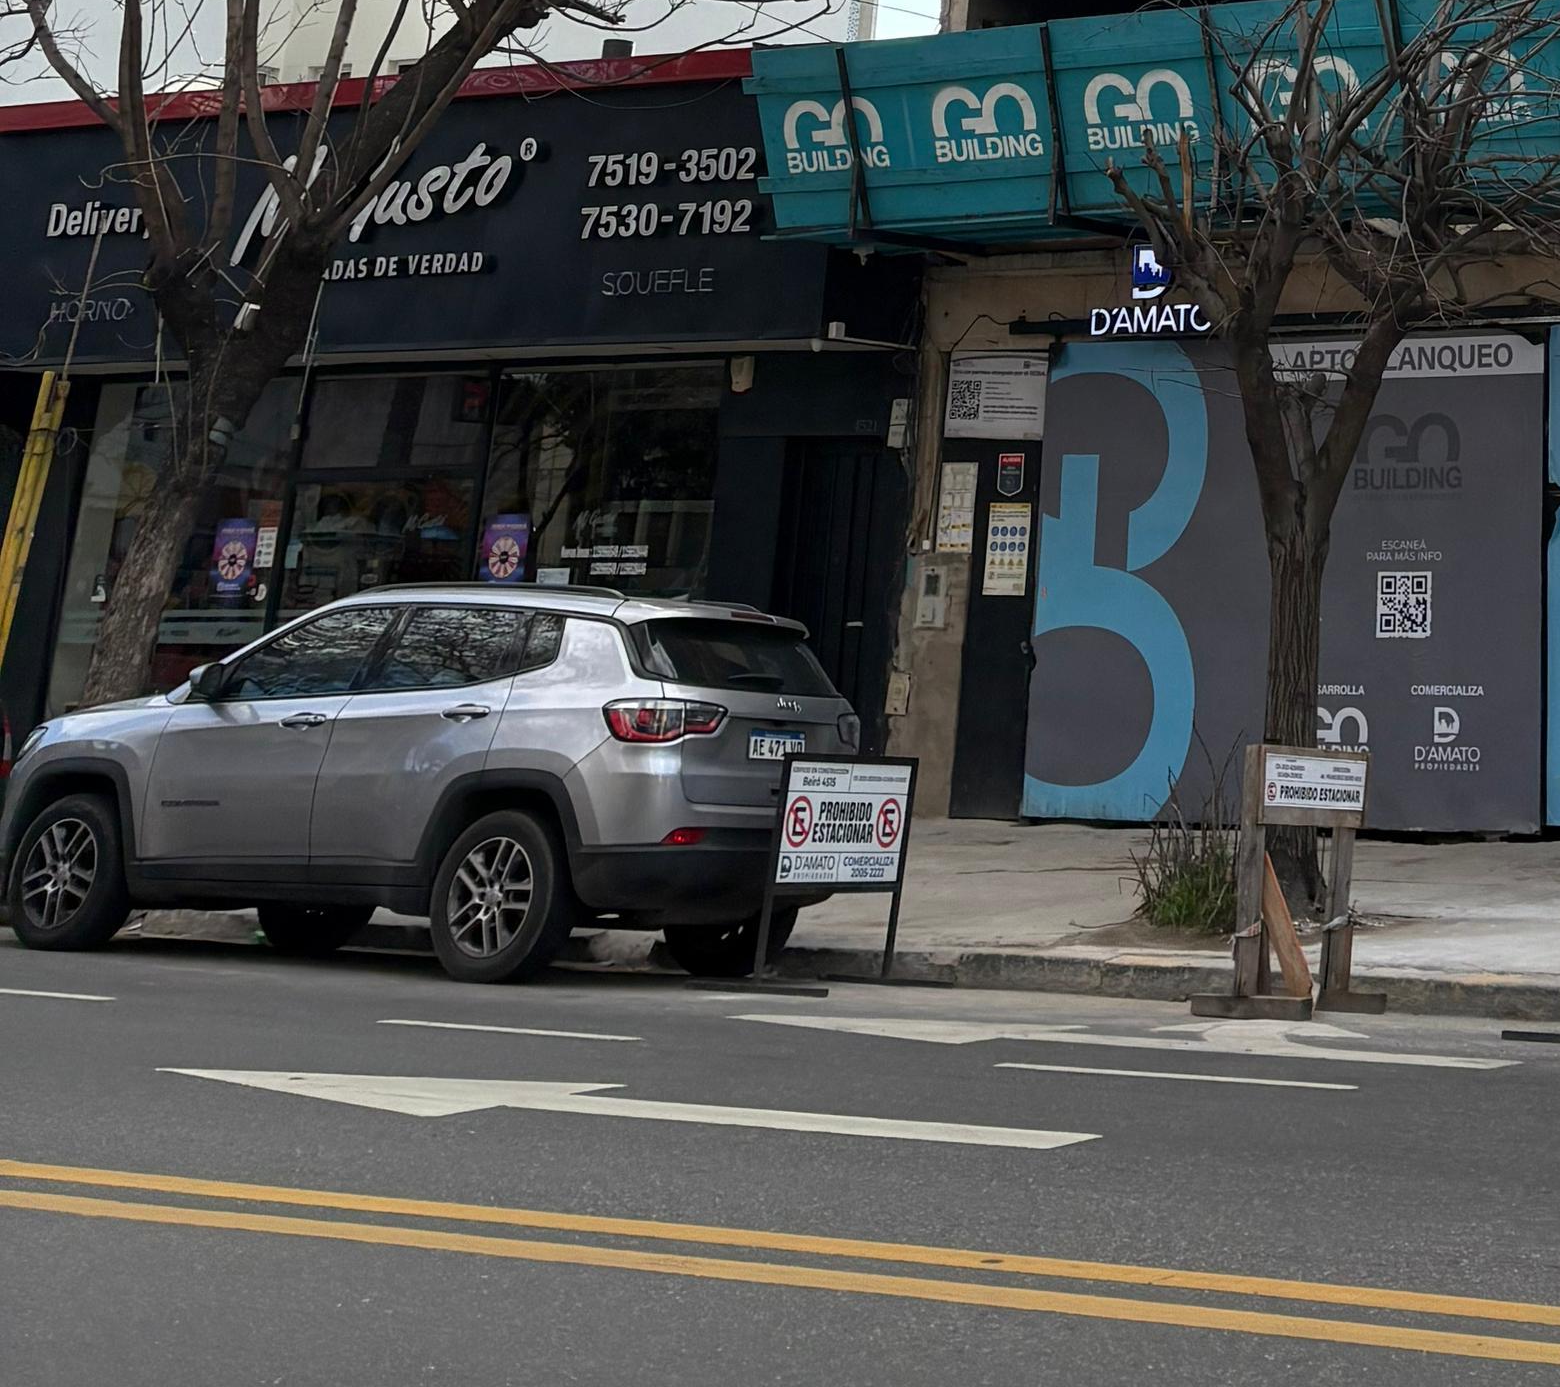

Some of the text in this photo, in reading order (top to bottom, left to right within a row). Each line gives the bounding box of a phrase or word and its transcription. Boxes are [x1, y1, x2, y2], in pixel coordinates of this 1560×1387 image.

[1084, 69, 1194, 125] GO
[932, 83, 1037, 139] GO
[784, 96, 883, 150] GO
[1087, 120, 1200, 151] BUILDING
[935, 133, 1044, 164] BUILDING
[373, 256, 398, 278] DE
[407, 252, 484, 275] VERDAD
[1356, 412, 1461, 465] GO
[1354, 466, 1463, 490] BUILDING
[1367, 551, 1393, 561] PARA
[1418, 551, 1443, 561] INFO
[1411, 685, 1484, 696] COMERCIALIZA
[752, 739, 765, 755] AE
[1414, 763, 1480, 771] PROPIEDADES
[1280, 785, 1361, 804] PROHIBIDO ESTACIONAR
[818, 802, 873, 822] PROHIBIDO
[812, 823, 874, 844] ESTACIONAR
[843, 856, 895, 867] COMERCIALIZA
